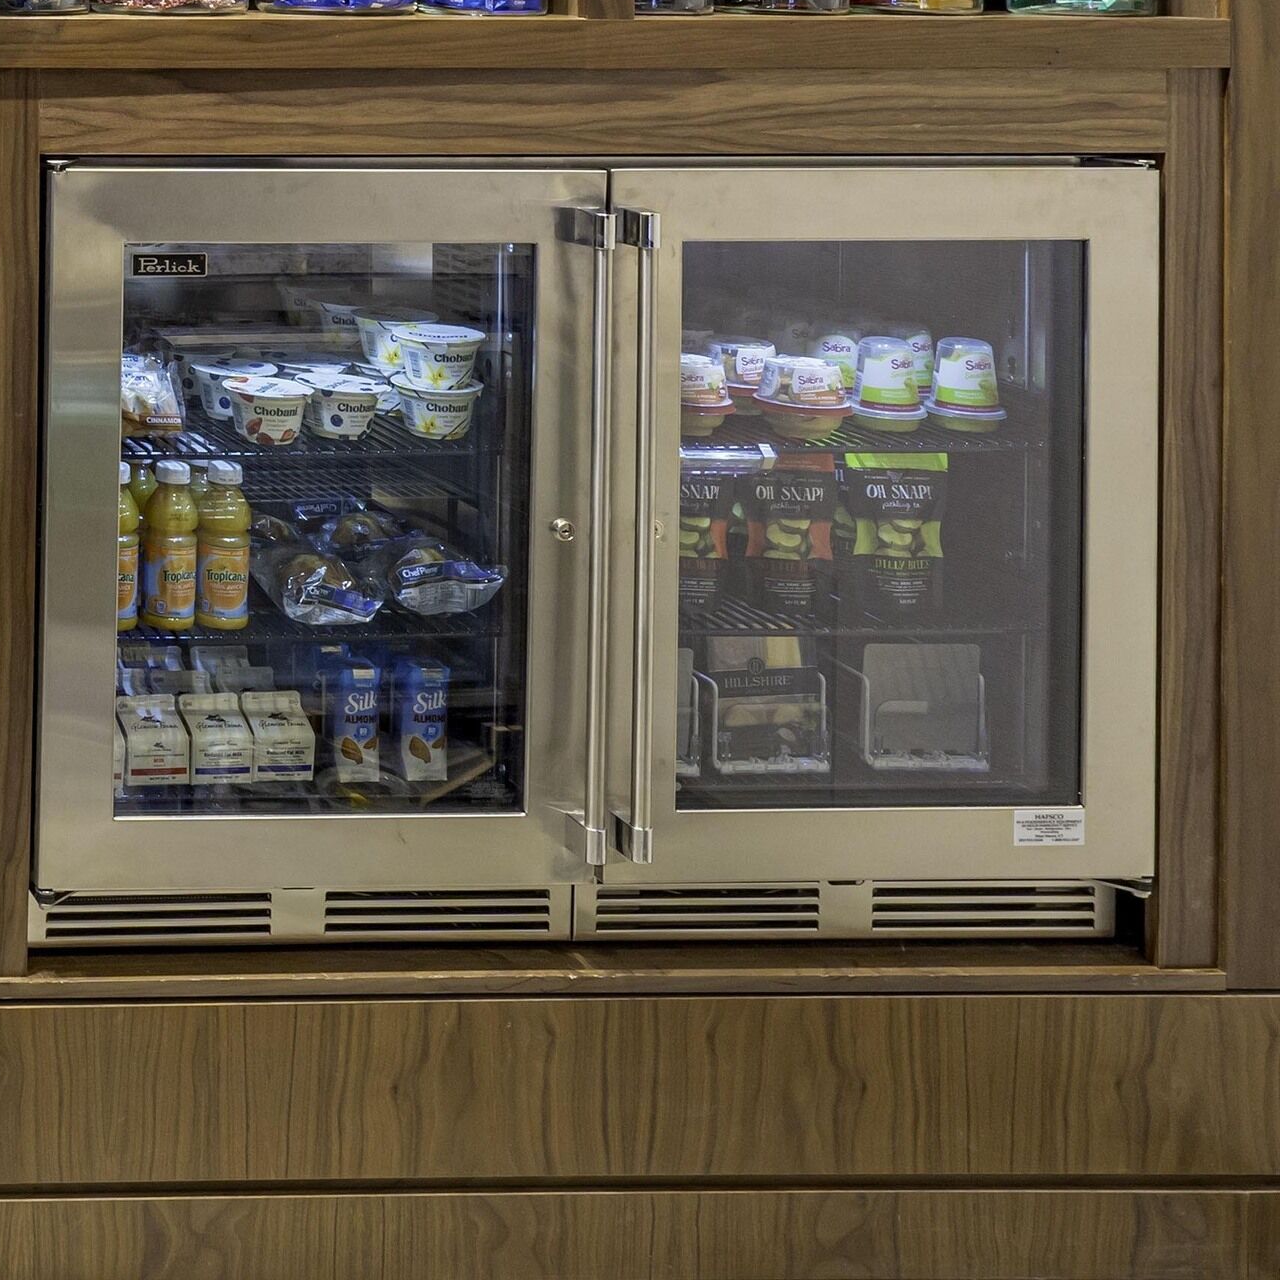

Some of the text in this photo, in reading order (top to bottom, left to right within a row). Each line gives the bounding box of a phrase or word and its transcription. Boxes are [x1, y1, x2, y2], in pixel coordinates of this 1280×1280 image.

[138, 256, 201, 273] Perlick
[822, 341, 851, 353] Sabra
[798, 374, 824, 385] Sabra
[254, 405, 299, 418] Chobani
[426, 402, 470, 413] Chobani
[755, 485, 825, 502] OH SNAP!
[865, 483, 933, 500] OH SNAP!
[724, 675, 792, 689] HILLSHIRE
[344, 690, 378, 715] Silk
[413, 689, 447, 714] Silk
